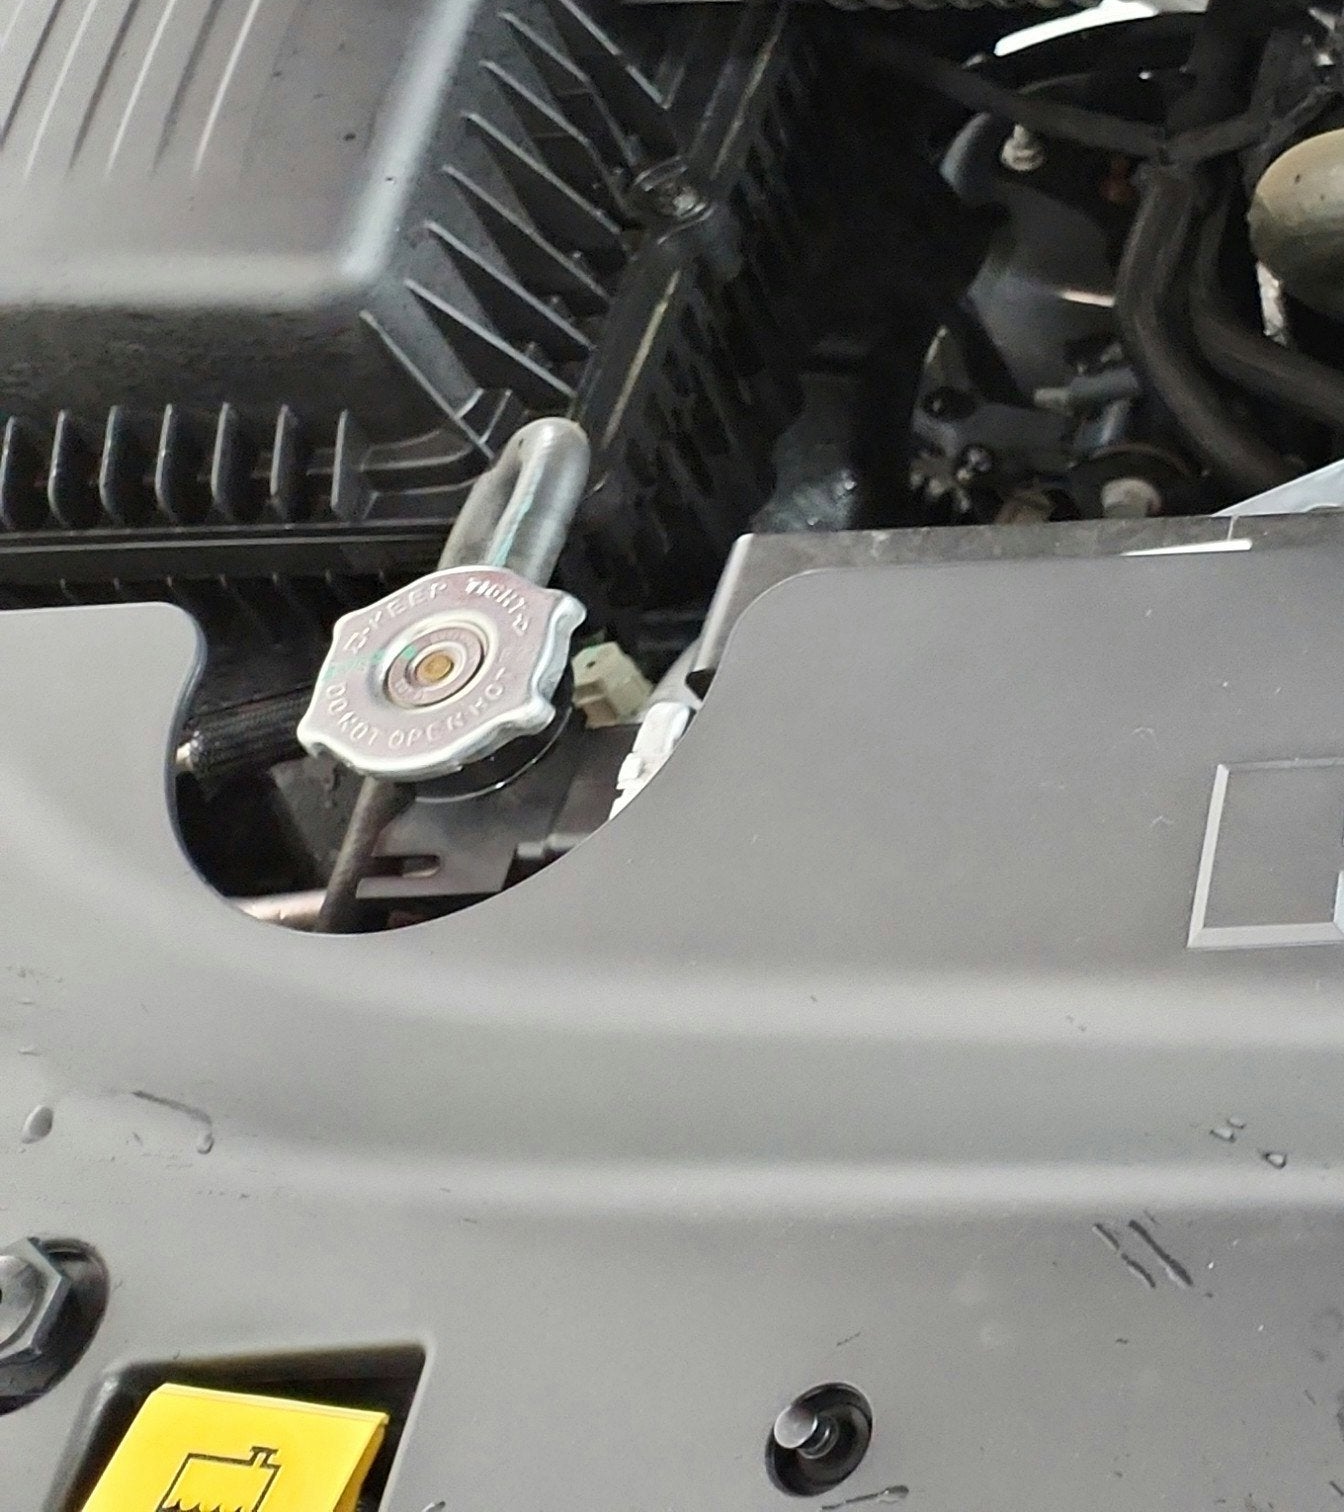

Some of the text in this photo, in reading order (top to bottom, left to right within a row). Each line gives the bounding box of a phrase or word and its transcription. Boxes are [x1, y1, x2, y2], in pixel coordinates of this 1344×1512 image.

[327, 680, 348, 715] DO
[338, 710, 379, 746] NOT
[388, 710, 464, 748] OPEN
